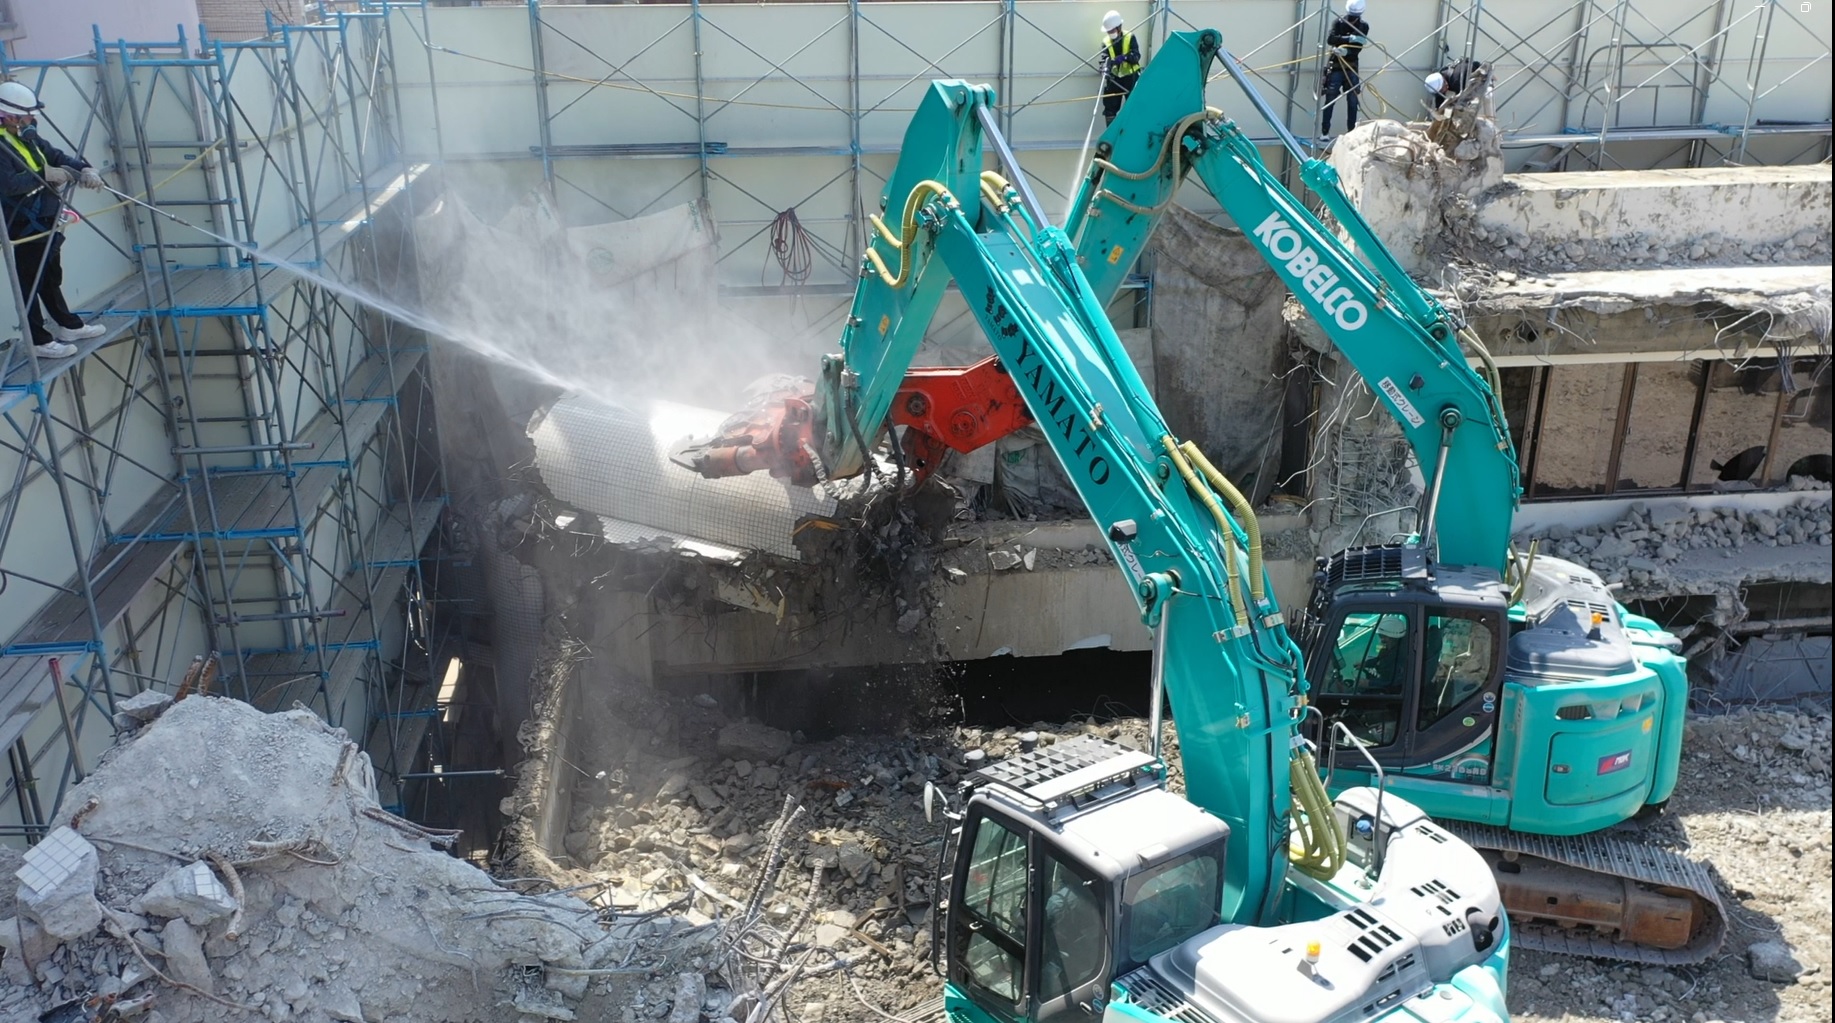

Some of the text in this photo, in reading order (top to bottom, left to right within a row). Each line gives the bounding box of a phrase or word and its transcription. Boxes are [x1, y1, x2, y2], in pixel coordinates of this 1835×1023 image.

[1253, 211, 1367, 331] KOBELCO
[1015, 336, 1110, 485] YAMATO
[1381, 380, 1421, 424] 移動式クレーン
